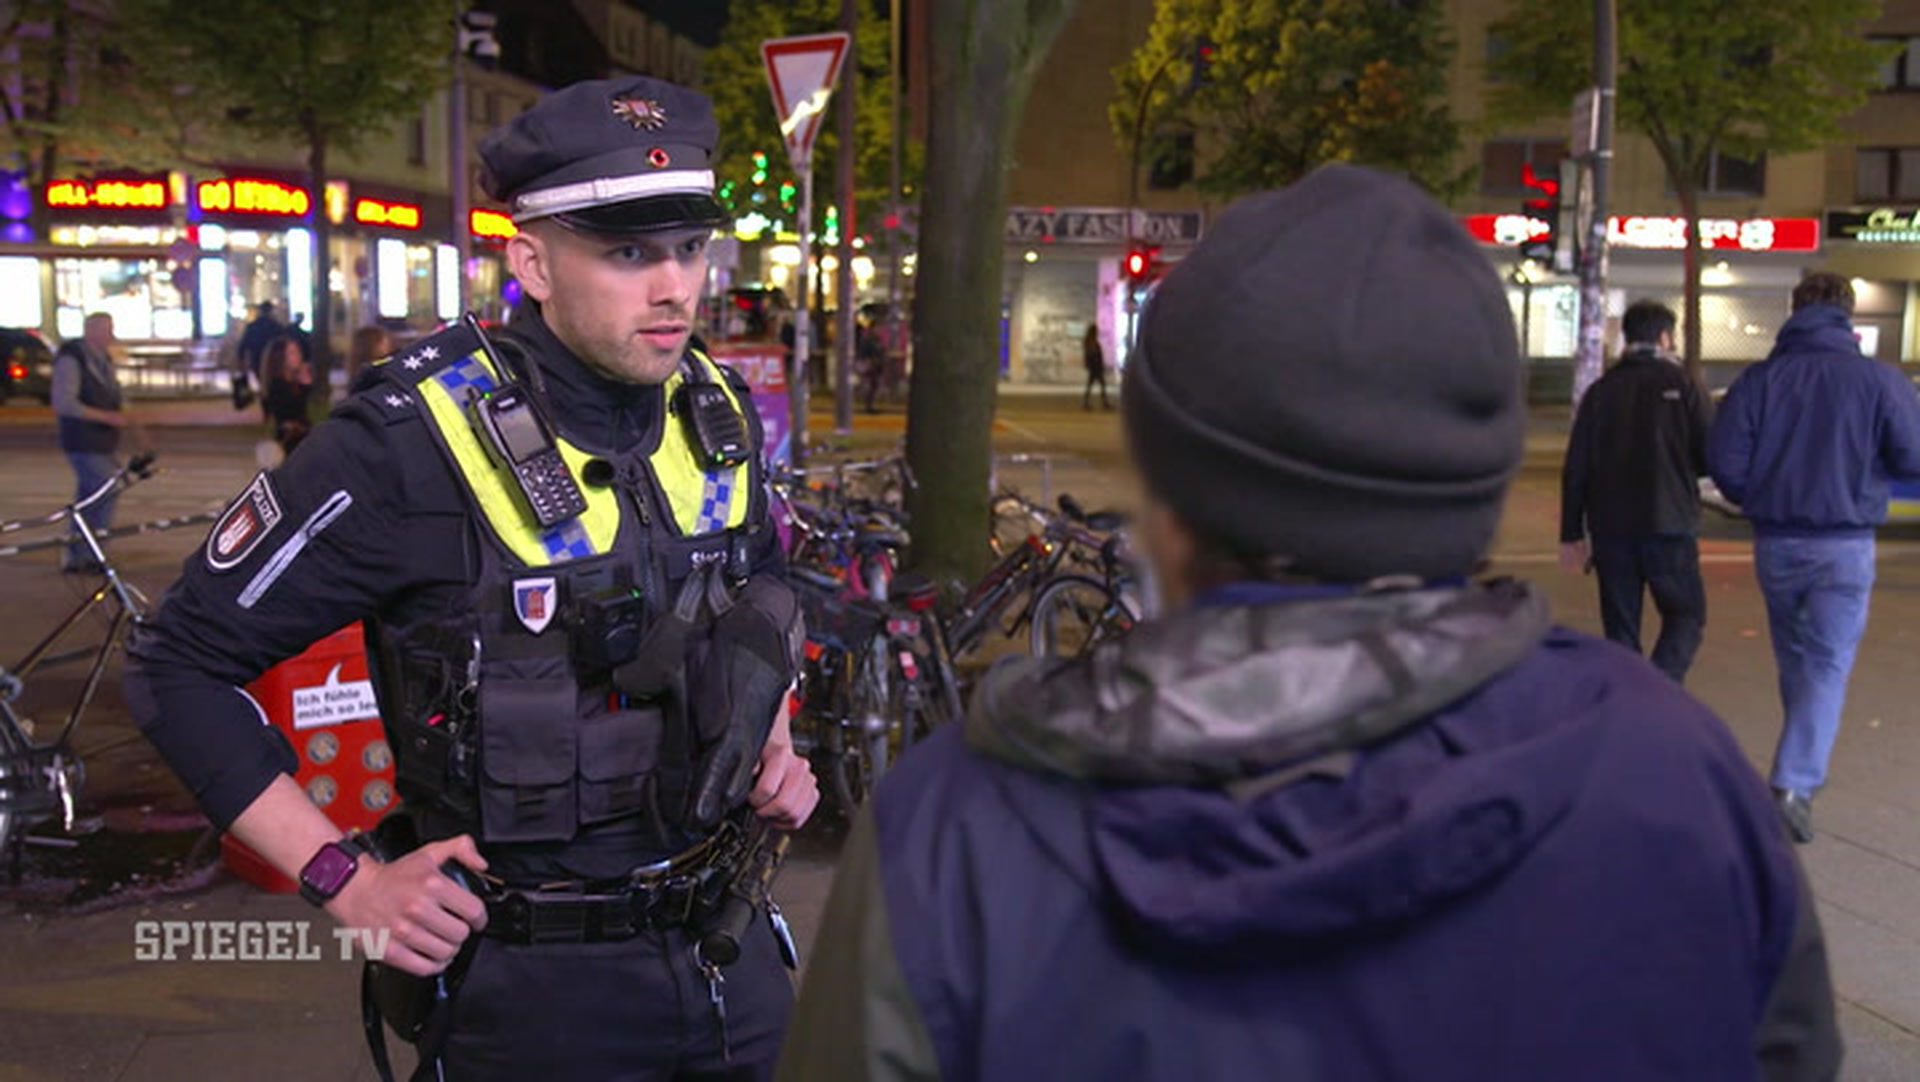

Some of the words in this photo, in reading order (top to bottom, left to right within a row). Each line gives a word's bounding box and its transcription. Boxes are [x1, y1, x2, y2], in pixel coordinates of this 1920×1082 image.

[1004, 214, 1060, 237] AZY
[1067, 214, 1184, 238] FASON
[296, 694, 320, 706] Ich
[297, 706, 334, 719] mich
[337, 704, 355, 714] so
